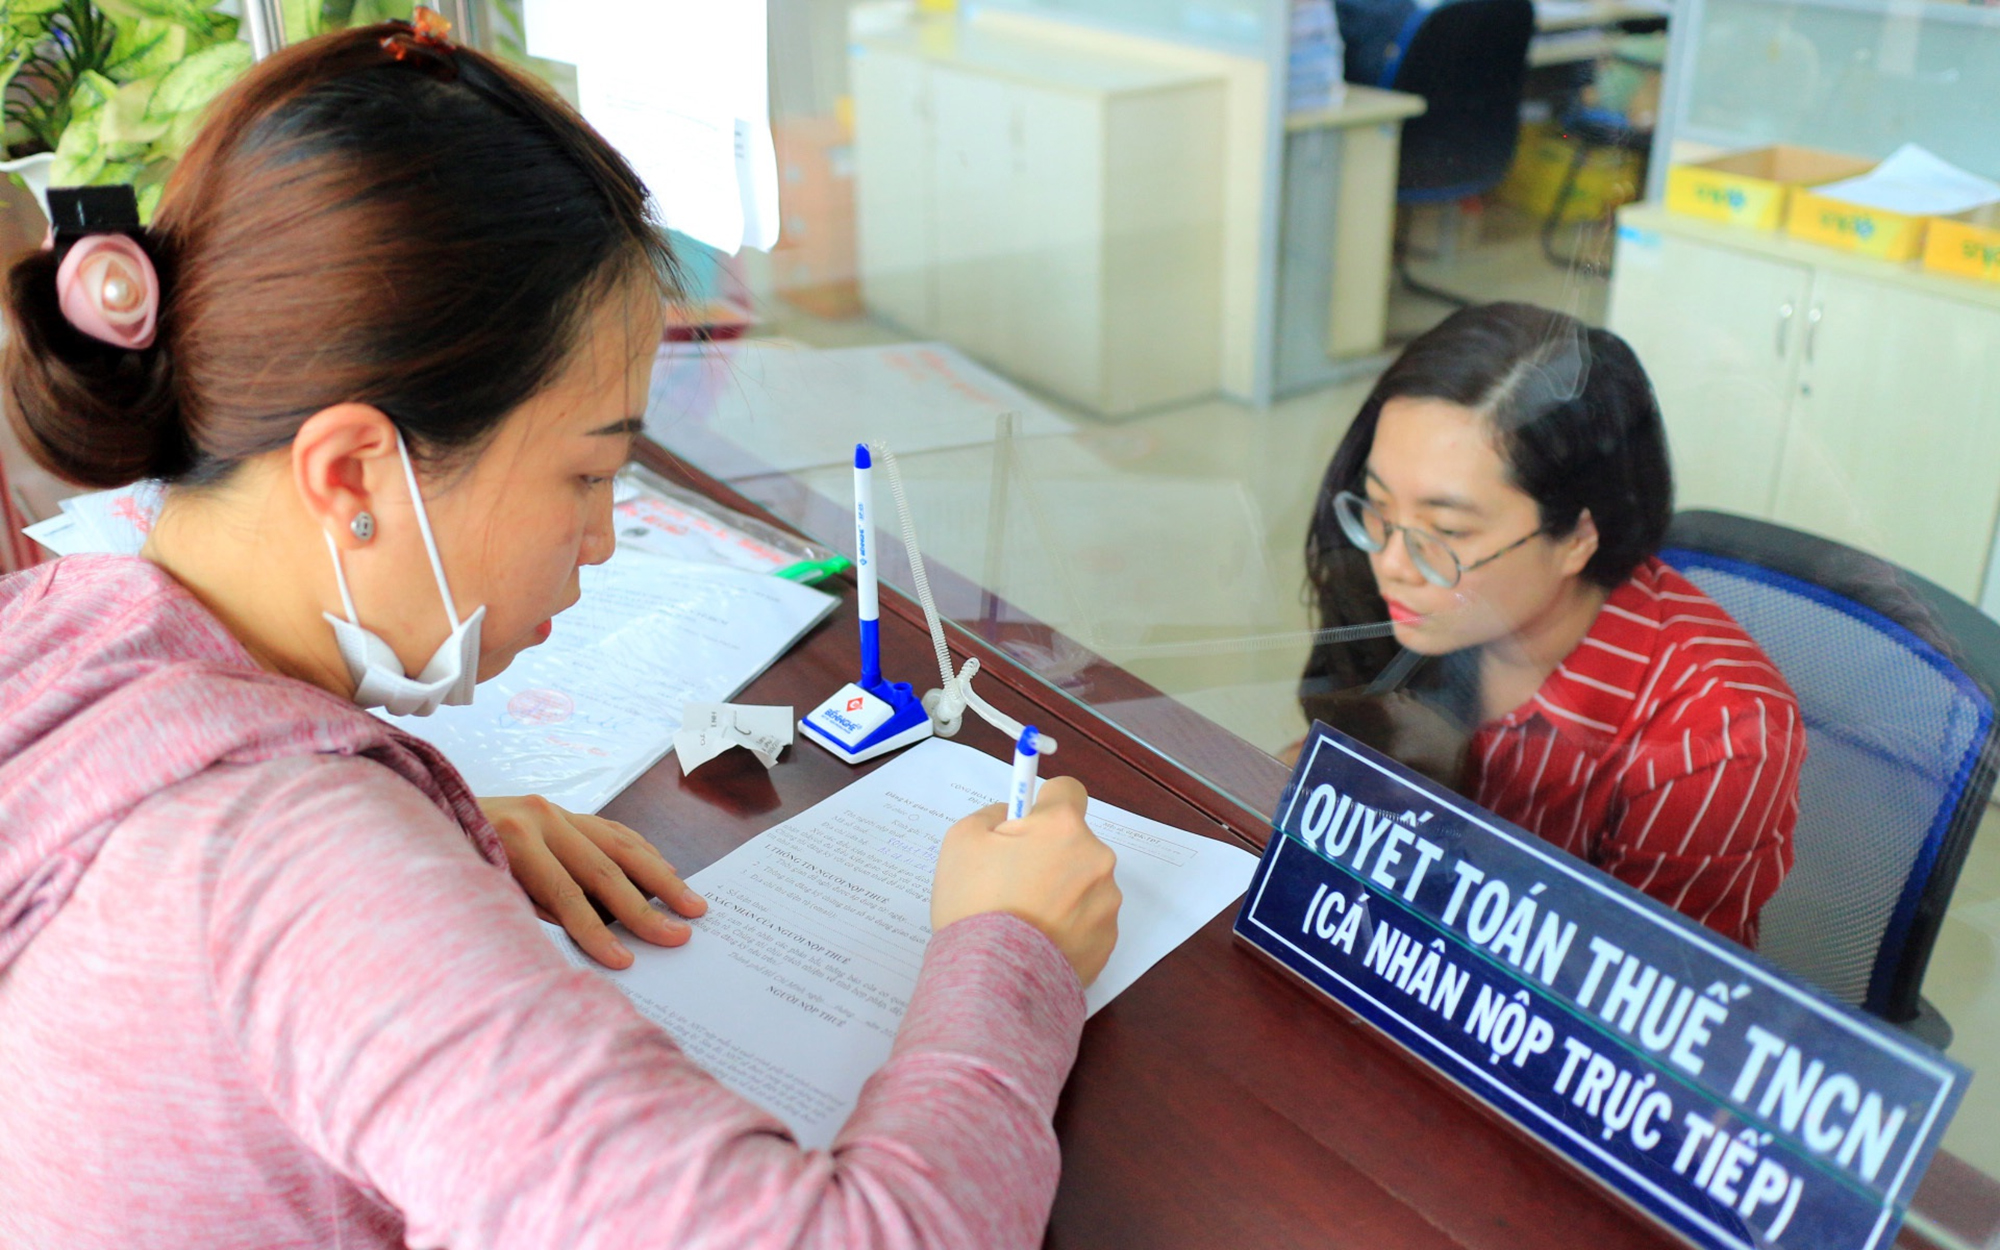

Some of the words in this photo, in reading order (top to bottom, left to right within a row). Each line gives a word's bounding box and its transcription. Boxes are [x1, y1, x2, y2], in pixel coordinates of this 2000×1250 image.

[912, 802, 930, 812] giao
[770, 846, 802, 863] THÔNG
[800, 861, 817, 870] TIN
[815, 868, 847, 884] NGƯỜI
[844, 882, 865, 894] NỘP
[864, 890, 890, 904] THUẾ
[729, 904, 758, 920] NHẬN
[754, 916, 776, 928] CỦA
[773, 924, 806, 943] NGƯỜI
[802, 939, 826, 953] NỘP
[823, 948, 852, 964] THUẾ
[765, 984, 800, 1004] NGƯỜI
[795, 1001, 820, 1015] NỘP
[817, 1010, 847, 1027] THUẾ
[1300, 783, 1442, 902] QUYẾT
[1441, 860, 1578, 986] TOÁN
[1576, 938, 1753, 1076] THUẾ
[1729, 1025, 1907, 1183] TNCN
[1302, 884, 1369, 955] (CÁ
[1367, 919, 1472, 1021] NHÂN
[1468, 985, 1555, 1066] NỘP
[1553, 1037, 1672, 1151] TRỰC
[1672, 1113, 1805, 1244] TIẾP)
